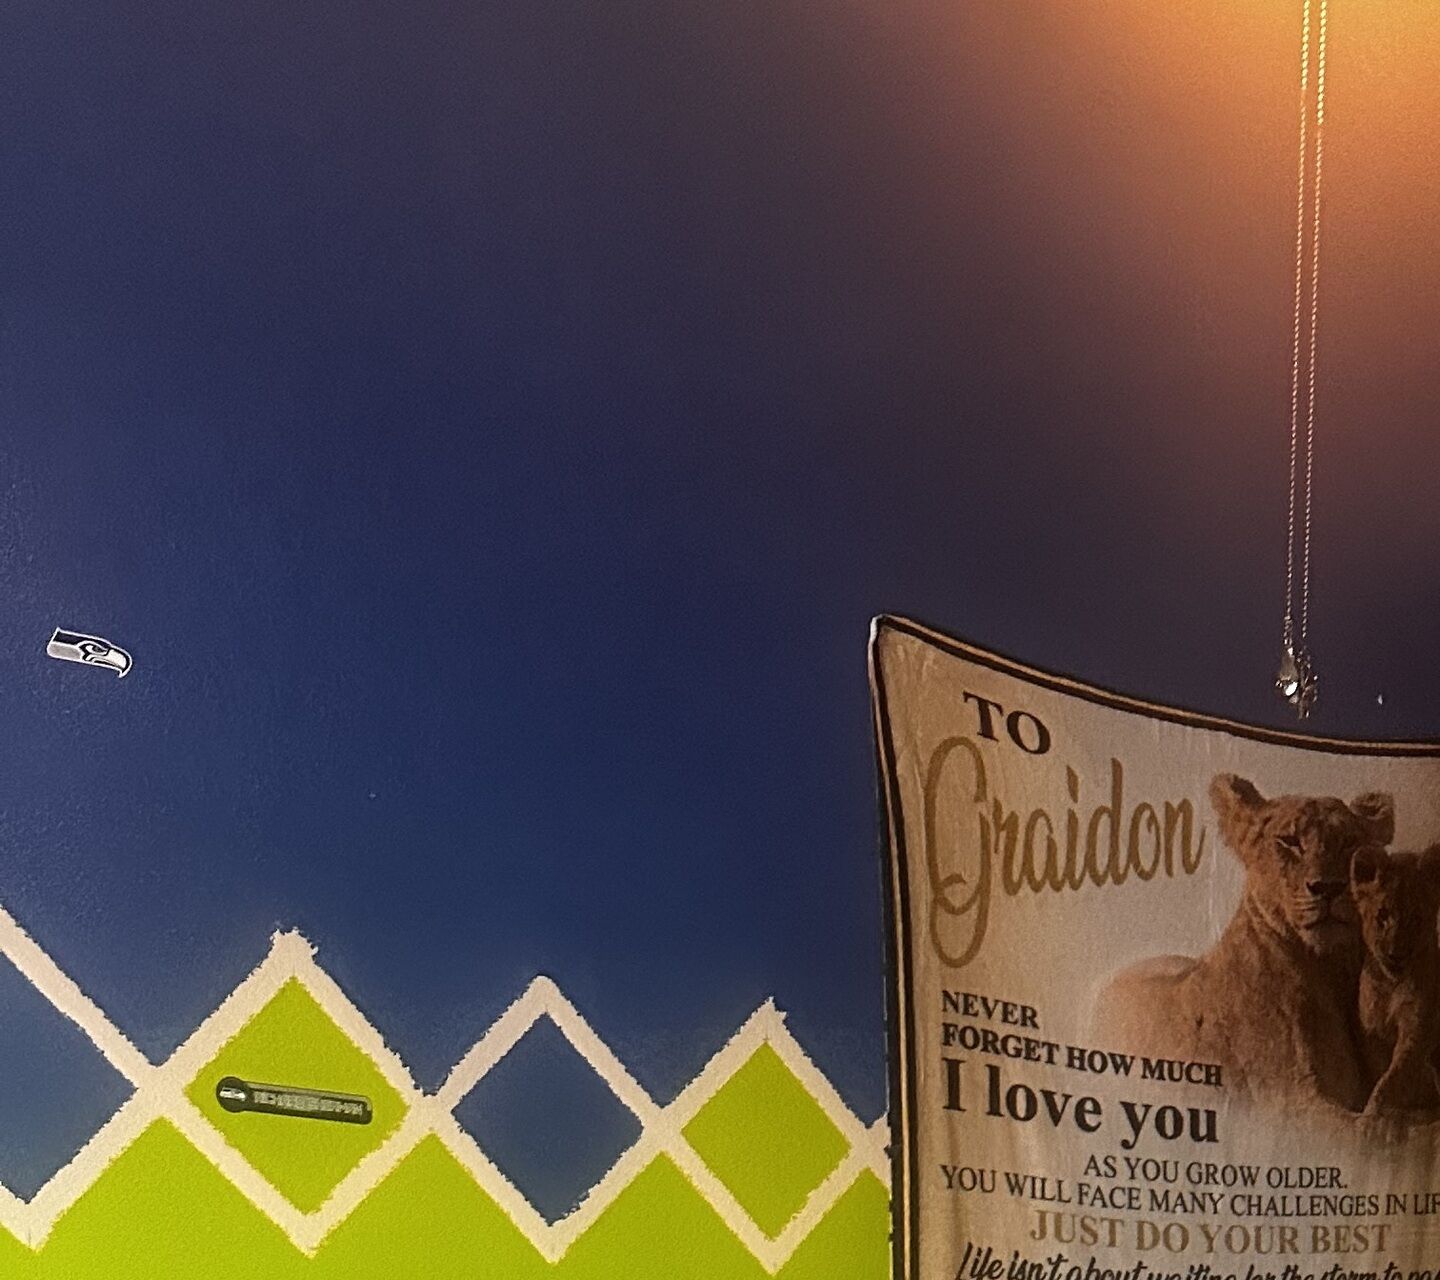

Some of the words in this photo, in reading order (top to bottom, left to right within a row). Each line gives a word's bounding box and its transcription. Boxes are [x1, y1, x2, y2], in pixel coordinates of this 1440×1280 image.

[963, 691, 1051, 755] TO
[924, 736, 1206, 968] Graidon
[942, 990, 1039, 1029] NEVER
[942, 1022, 1059, 1065] FORGET
[1065, 1045, 1136, 1077] HOW
[1141, 1057, 1223, 1087] MUCH
[942, 1057, 966, 1112] I
[986, 1064, 1102, 1132] love
[1120, 1100, 1219, 1149] you
[940, 1164, 997, 1193] YOU
[1004, 1172, 1071, 1203] WILL
[1077, 1182, 1142, 1210] FACE
[1150, 1188, 1225, 1214] MANY
[1230, 1194, 1379, 1217] CHALLENGES
[1385, 1194, 1407, 1215] IN
[1084, 1155, 1117, 1178] AS
[1124, 1157, 1180, 1183] YOU
[1186, 1161, 1261, 1188] GROW
[1266, 1166, 1348, 1189] OLDER.
[1030, 1209, 1125, 1248] JUST
[1135, 1220, 1190, 1253] DO
[1200, 1224, 1299, 1254] YOUR
[1311, 1223, 1392, 1254] BEST
